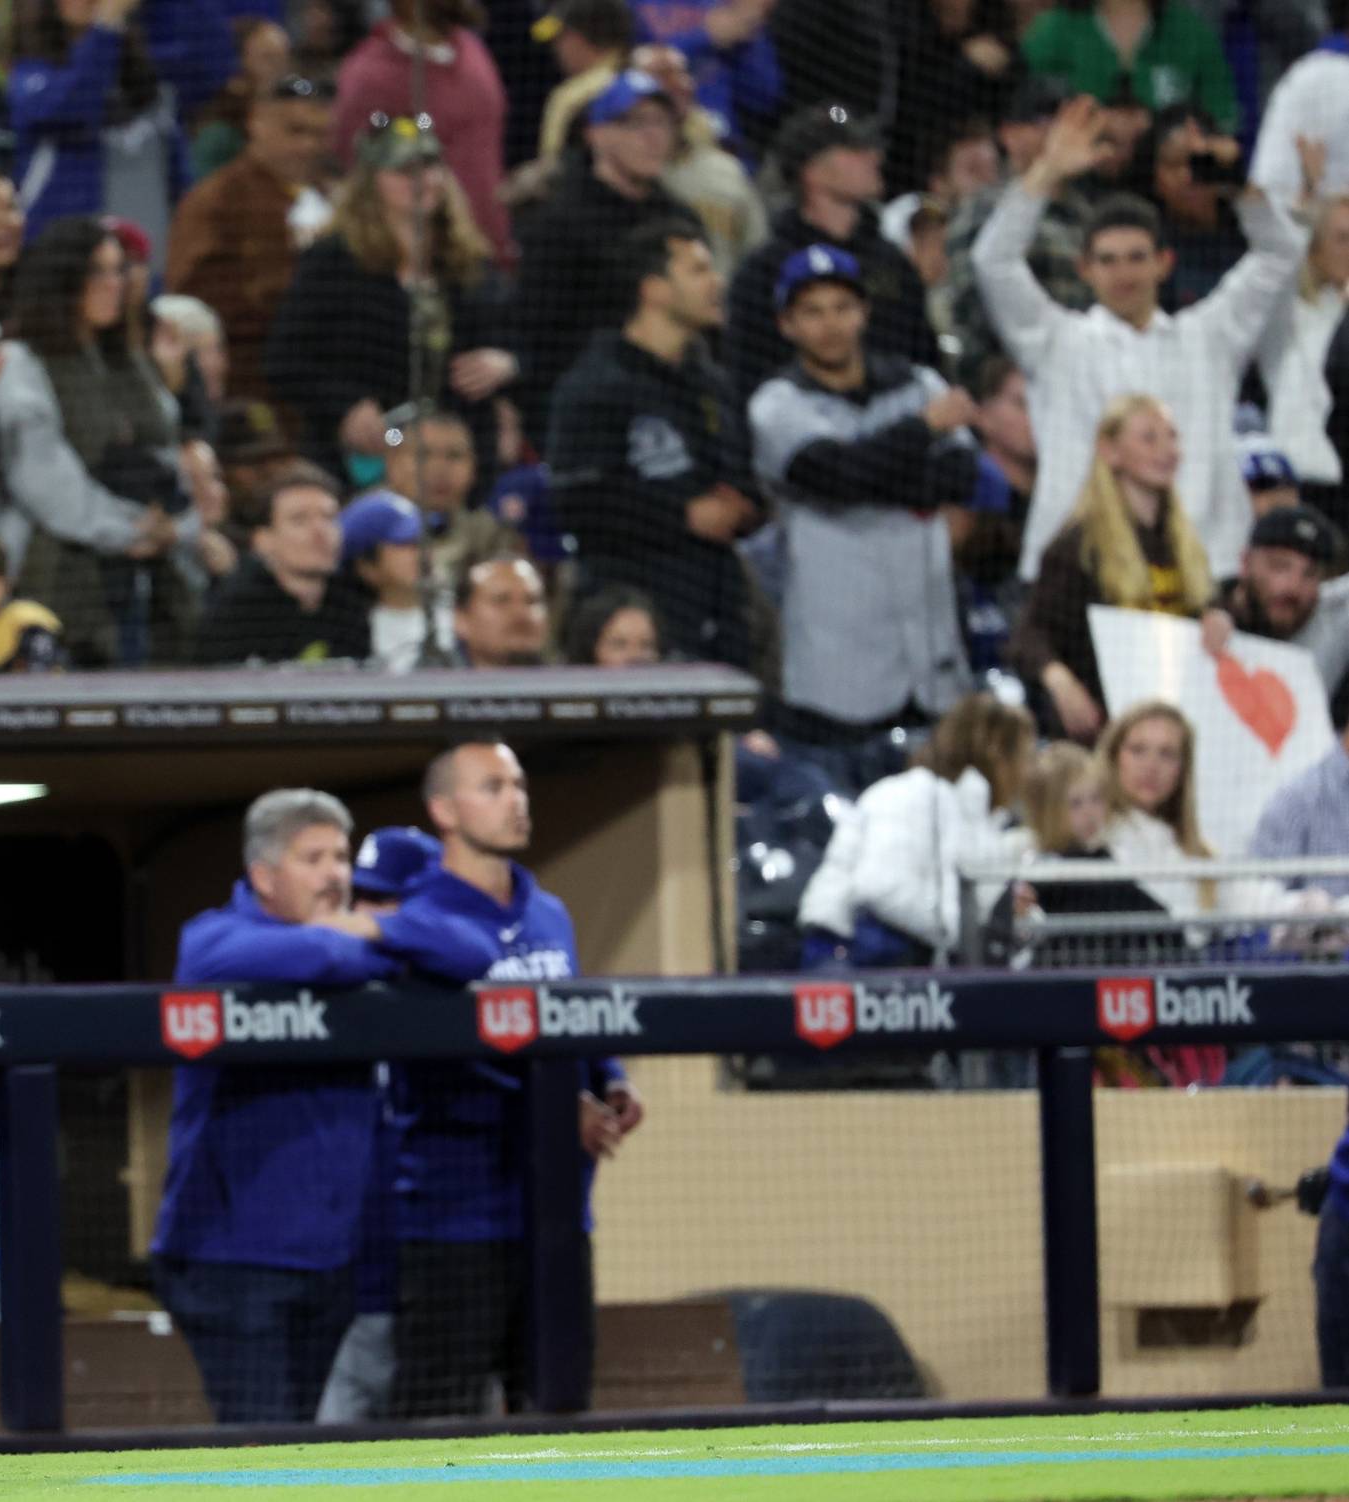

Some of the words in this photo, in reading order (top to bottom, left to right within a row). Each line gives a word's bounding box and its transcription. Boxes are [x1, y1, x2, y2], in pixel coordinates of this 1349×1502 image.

[165, 1002, 219, 1043] us
[223, 990, 330, 1042] bank
[483, 998, 532, 1036] us
[538, 984, 643, 1036] bank
[801, 994, 849, 1033] us
[855, 979, 956, 1033] bank
[1103, 986, 1149, 1026] us
[1156, 974, 1254, 1026] bank
